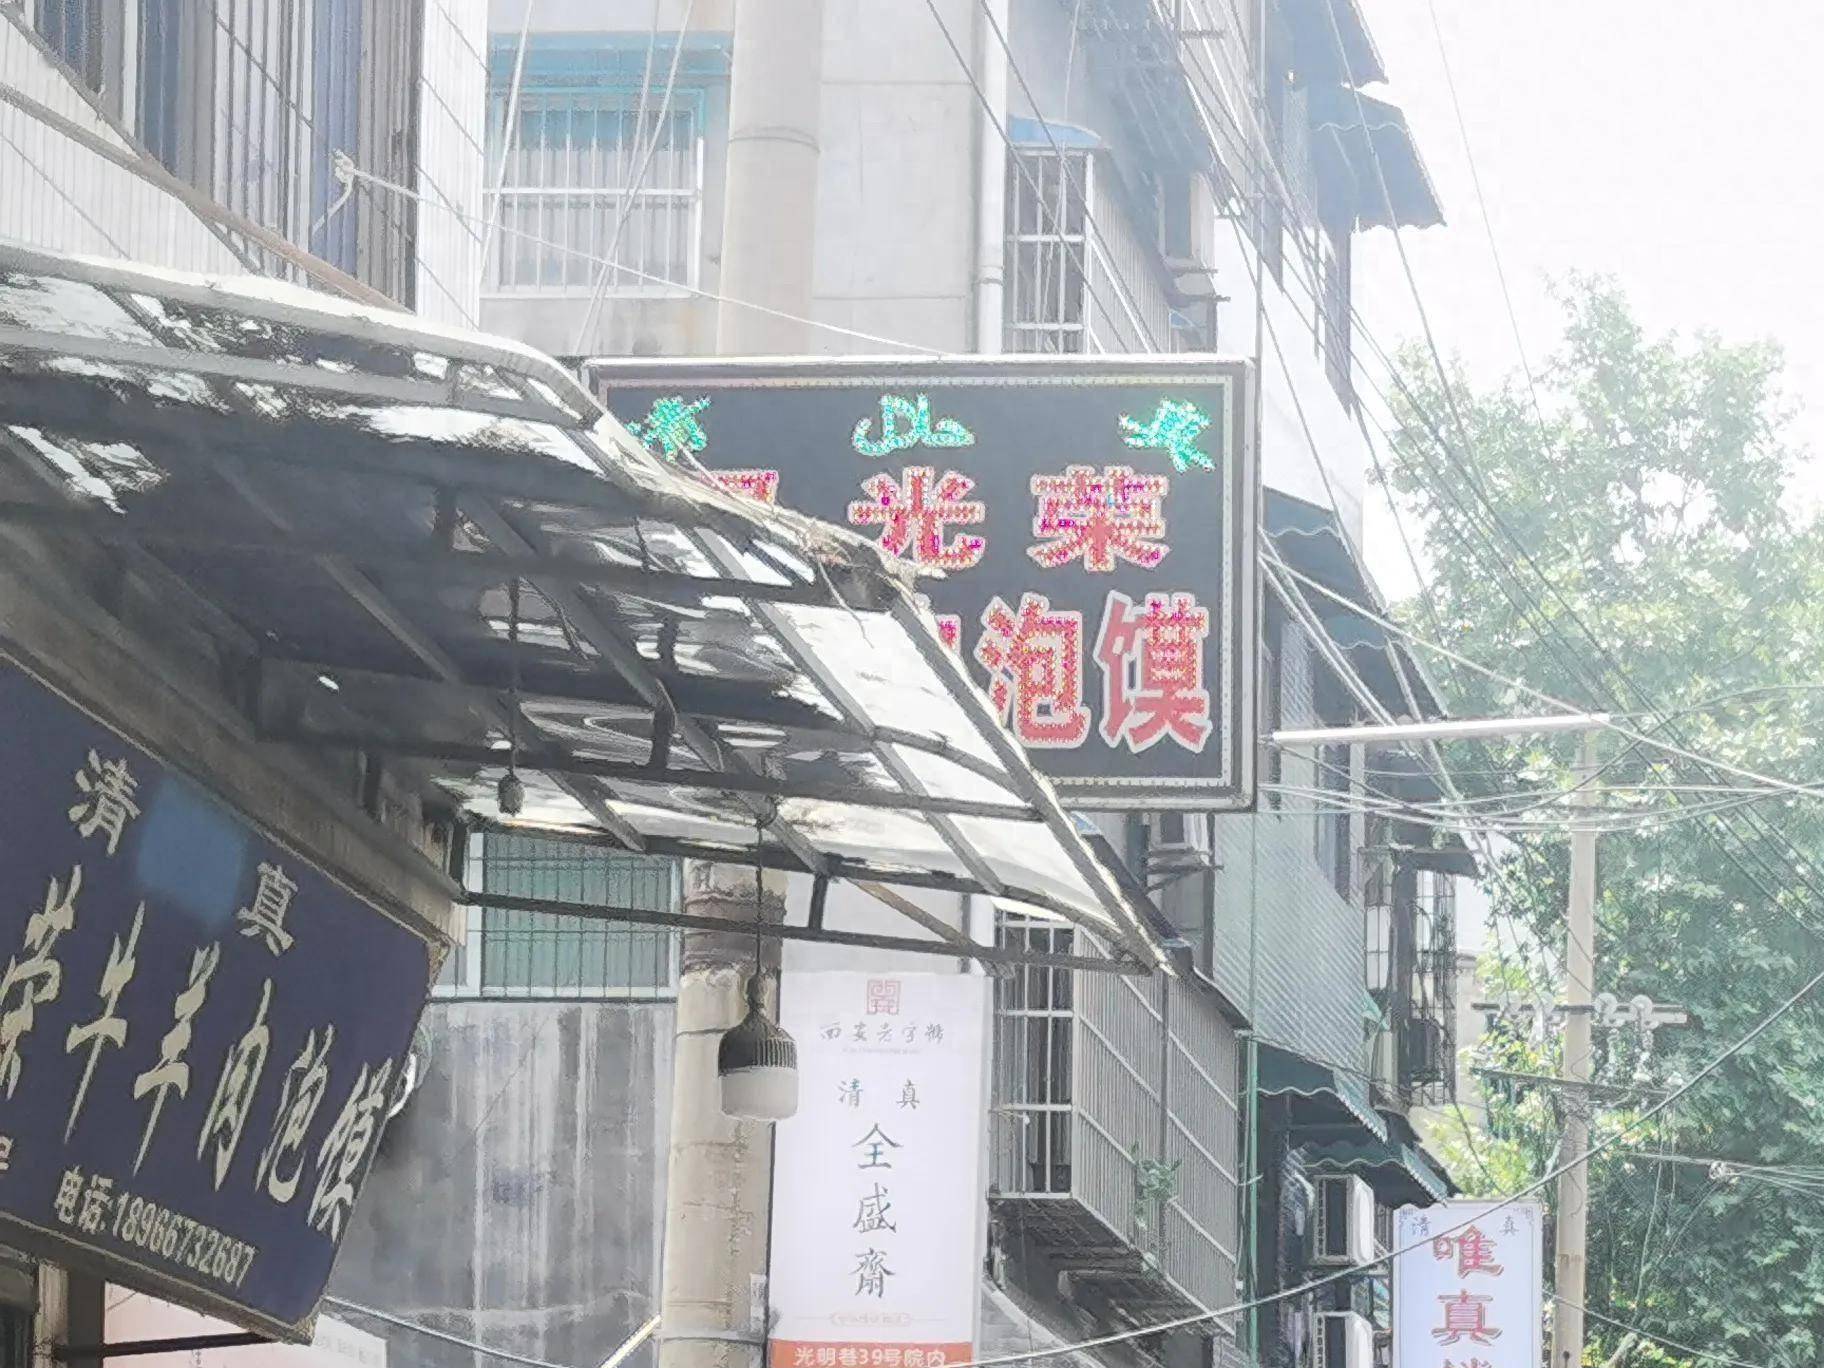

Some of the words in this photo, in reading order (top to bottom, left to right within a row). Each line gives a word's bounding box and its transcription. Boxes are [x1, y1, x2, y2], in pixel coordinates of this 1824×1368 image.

[710, 465, 1170, 572] 光荣
[918, 592, 1213, 753] 泡馍
[836, 1078, 920, 1109] 清真
[793, 1346, 946, 1368] 光明巷39号院内
